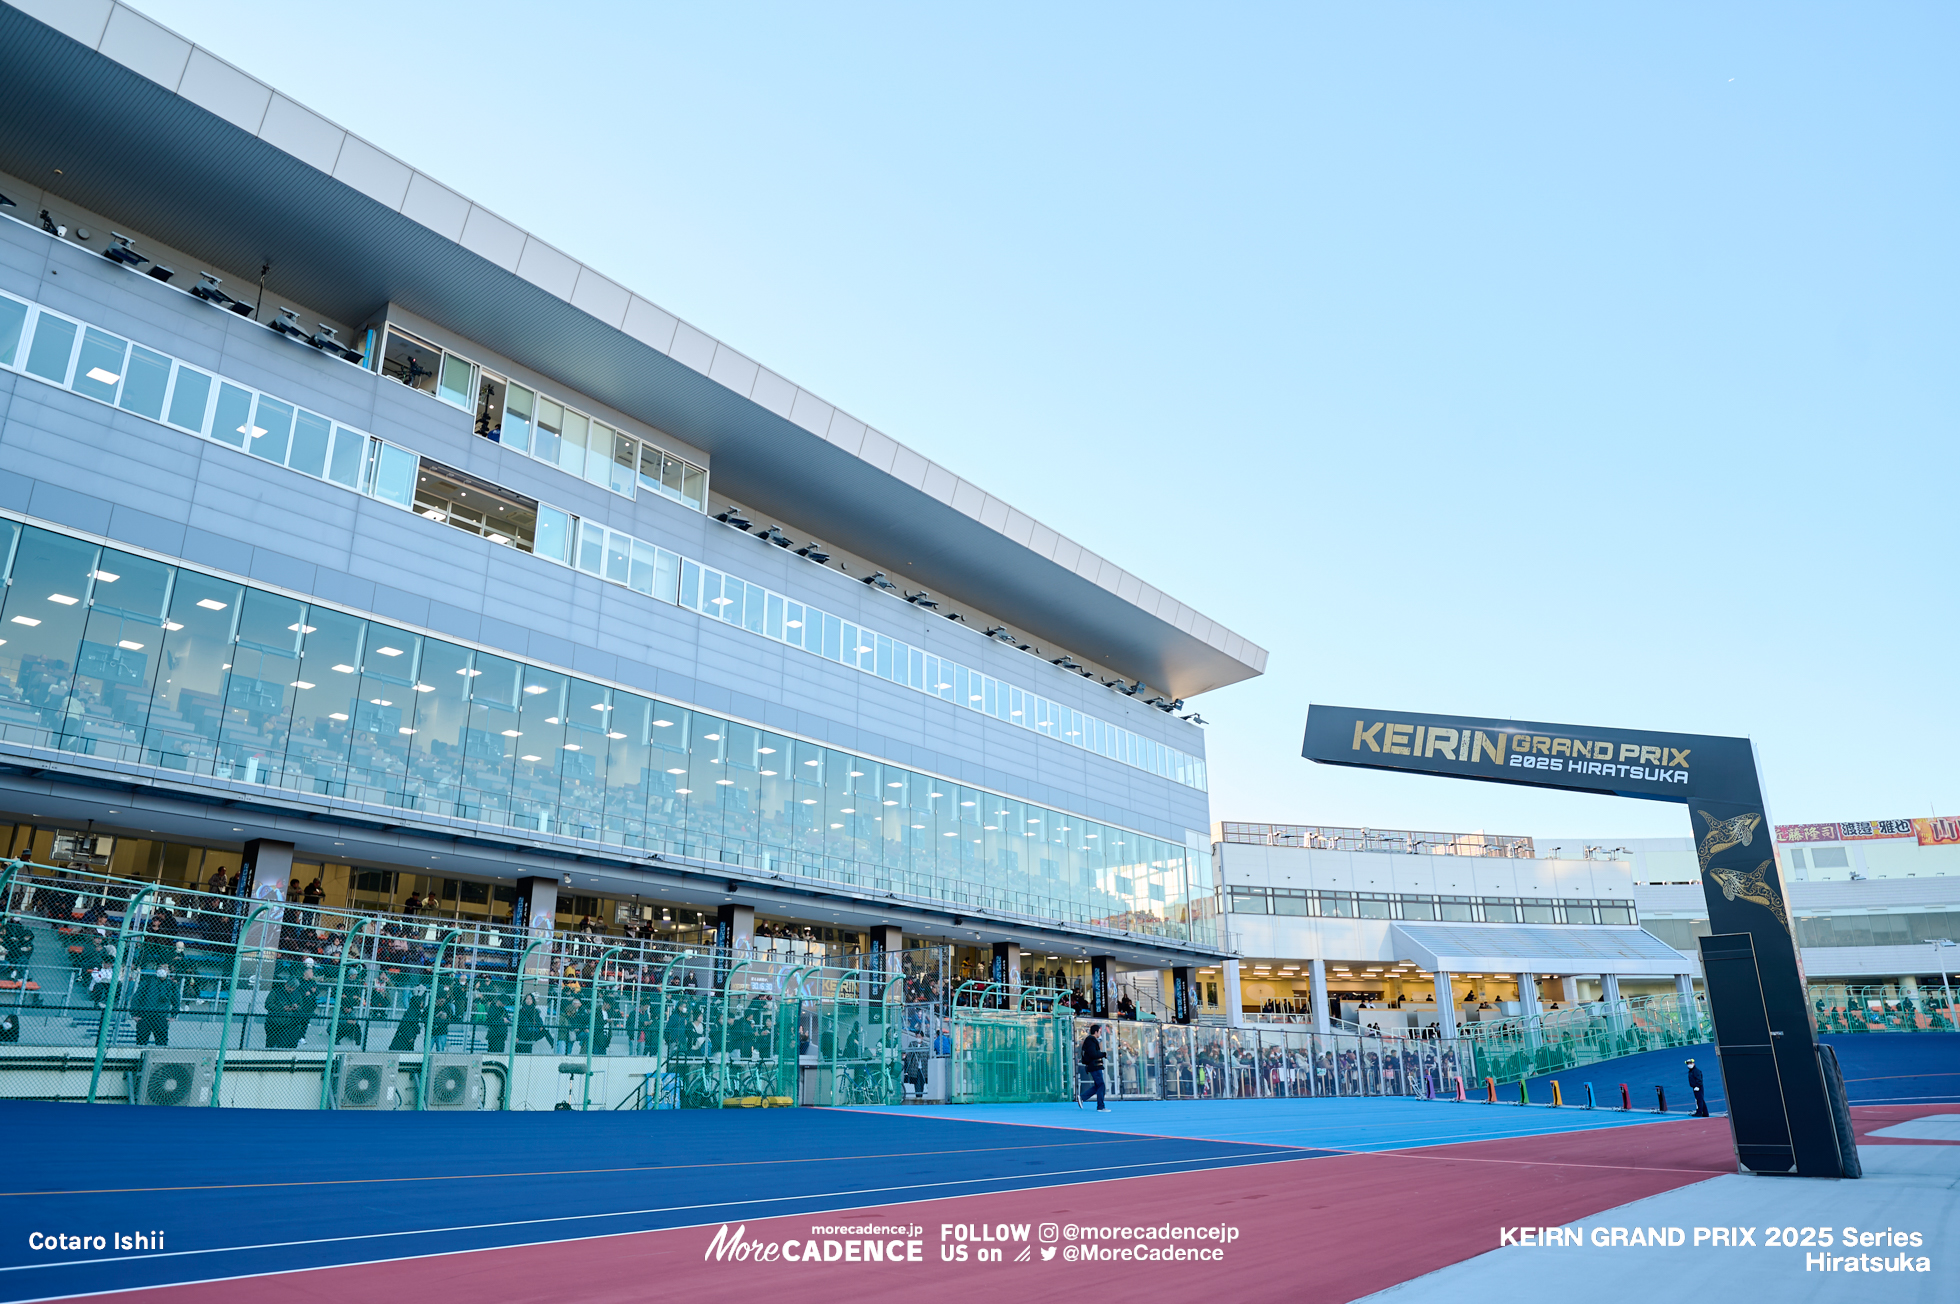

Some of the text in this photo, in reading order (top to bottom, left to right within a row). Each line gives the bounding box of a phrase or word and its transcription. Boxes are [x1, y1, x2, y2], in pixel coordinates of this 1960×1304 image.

[1352, 720, 1692, 768] KEIRIN GRAND PRIX
[1509, 754, 1689, 785] 2025 HIRATSUKA
[822, 980, 860, 993] KERIN
